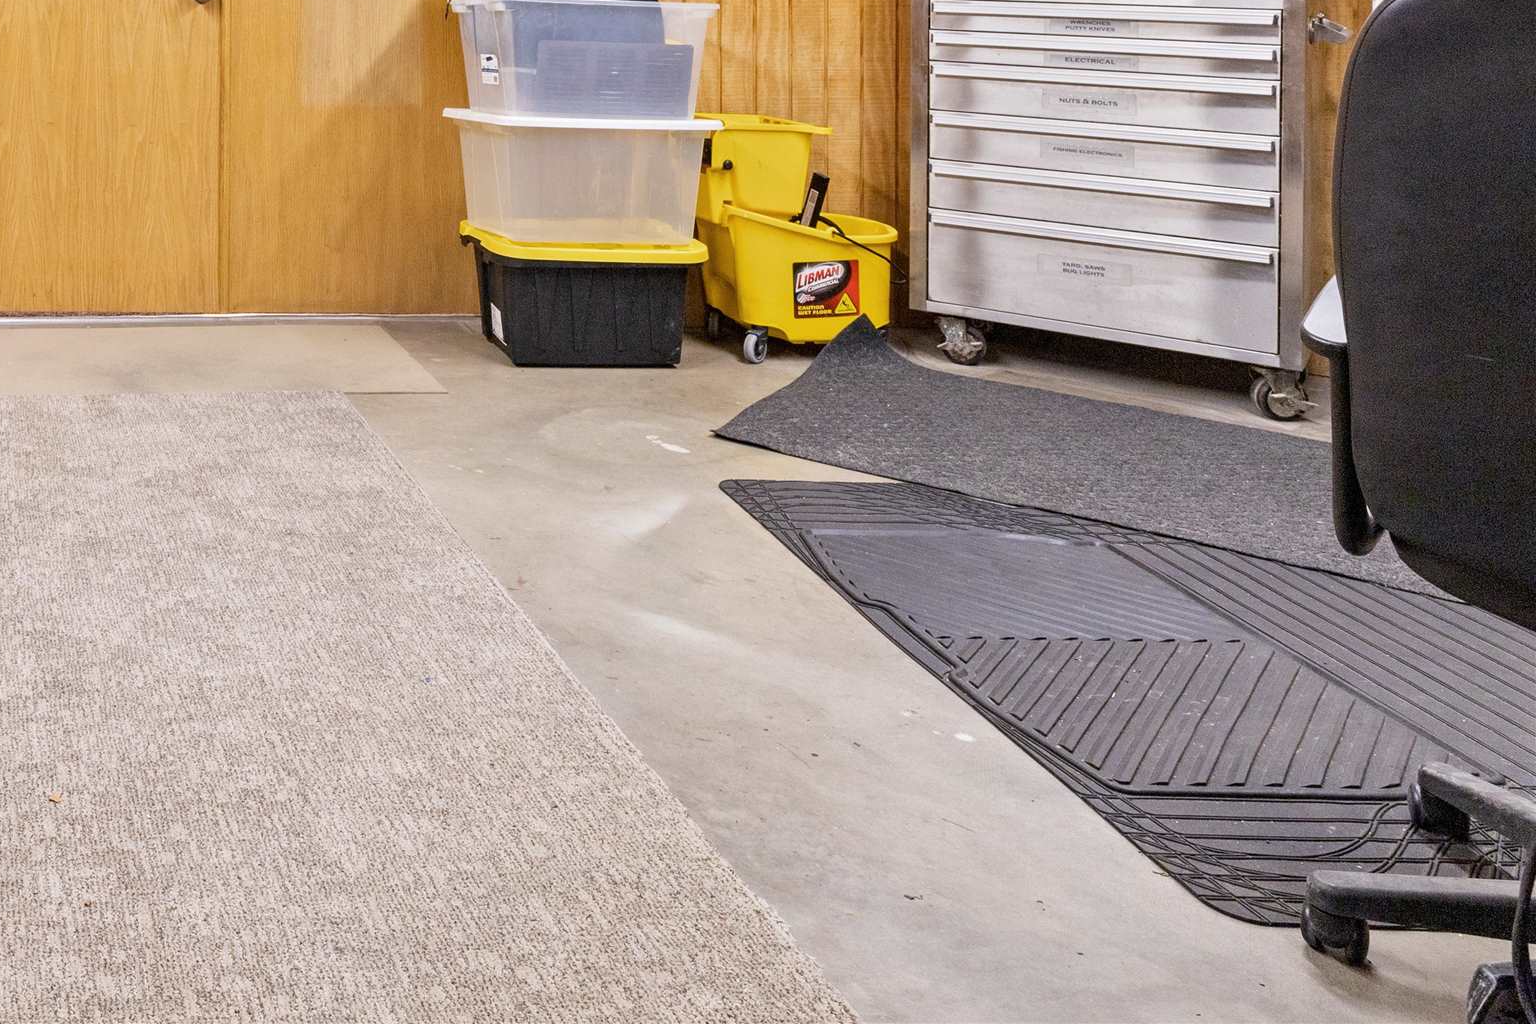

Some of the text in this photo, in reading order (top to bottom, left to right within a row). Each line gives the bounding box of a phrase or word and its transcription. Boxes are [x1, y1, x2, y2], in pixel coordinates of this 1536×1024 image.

[1065, 56, 1116, 65] ELECTRICAL
[1091, 99, 1119, 107] BOLTS
[1079, 149, 1123, 157] ELECTRONICS
[796, 266, 840, 288] LIBMAN
